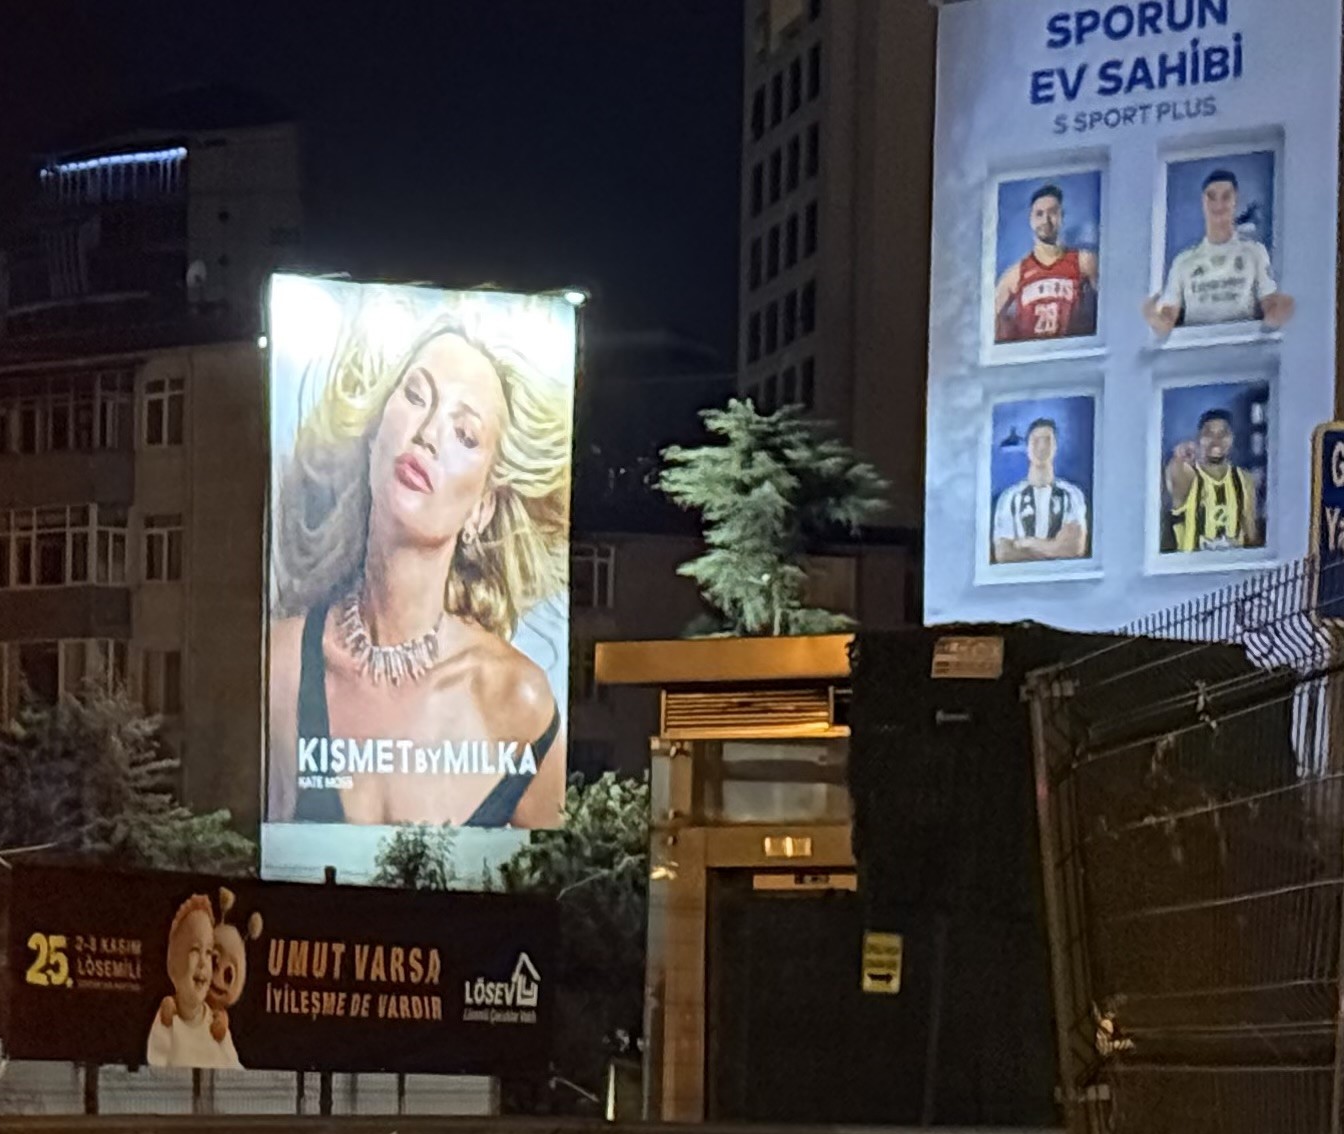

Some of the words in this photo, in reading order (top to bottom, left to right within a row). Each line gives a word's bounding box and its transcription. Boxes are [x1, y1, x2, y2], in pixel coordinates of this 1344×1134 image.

[1046, 0, 1228, 49] SPORUN
[1030, 64, 1088, 105] EV
[1097, 32, 1243, 96] SAHİBİ
[1053, 113, 1068, 134] S
[1073, 103, 1152, 132] SPORT
[1156, 96, 1217, 122] PLUS
[268, 938, 346, 980] UMUT
[355, 944, 442, 985] VARSA
[266, 982, 347, 1021] İYİLEŞME
[350, 992, 372, 1017] DE
[378, 994, 443, 1021] VARDIR
